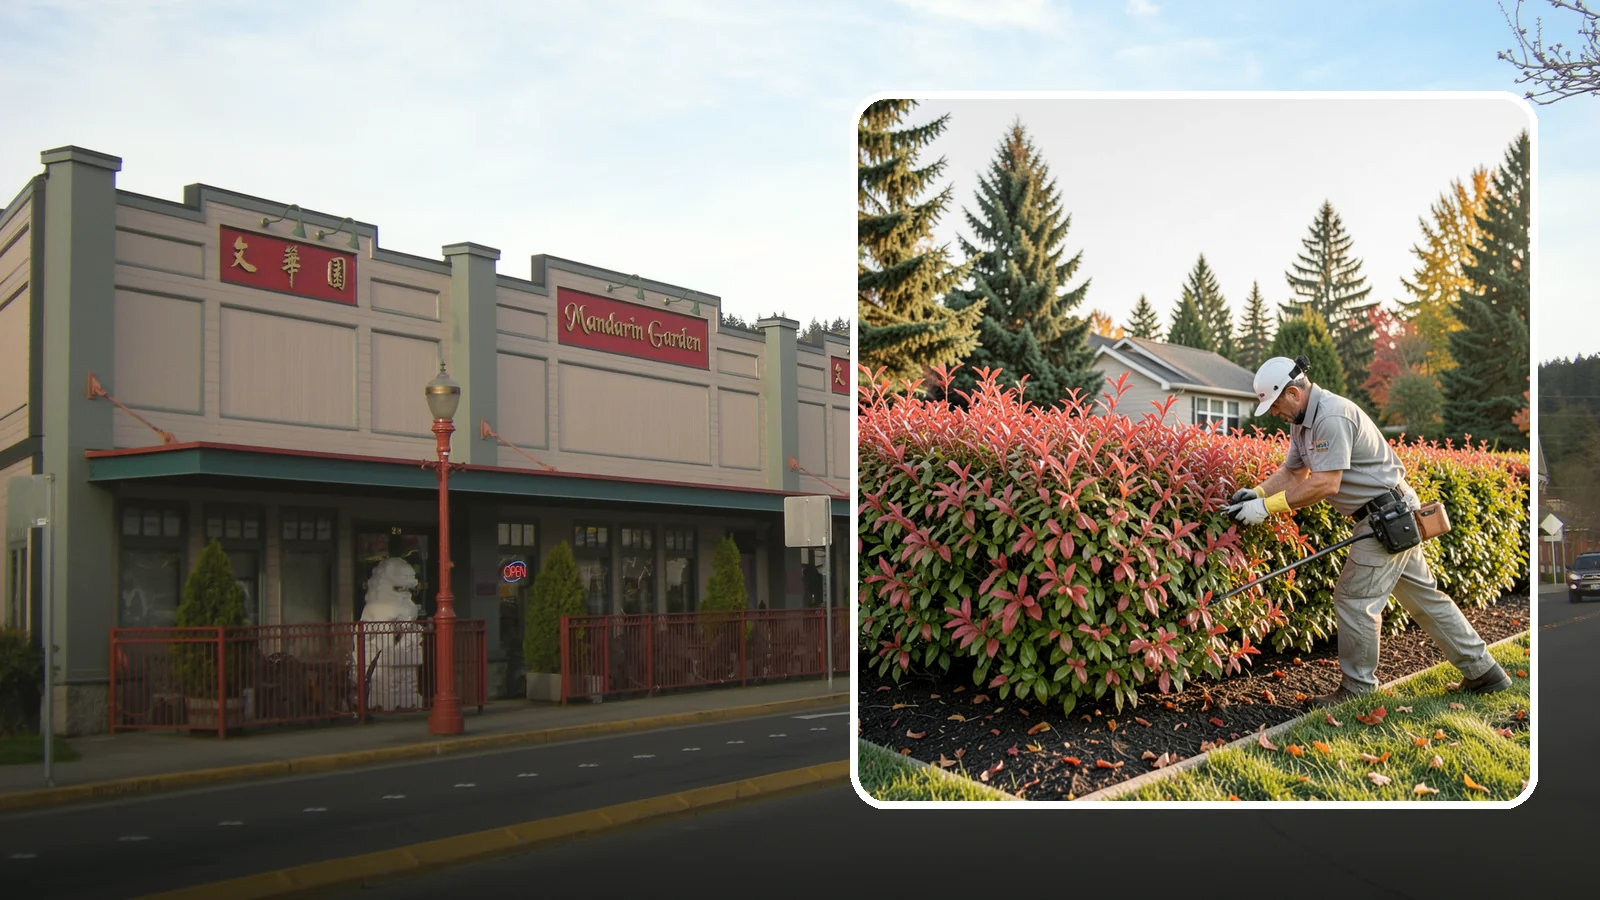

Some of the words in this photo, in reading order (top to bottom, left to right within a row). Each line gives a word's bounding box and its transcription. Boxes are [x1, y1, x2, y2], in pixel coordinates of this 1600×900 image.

[230, 236, 346, 291] 文華園
[564, 302, 644, 341] Mandarin
[648, 320, 702, 352] Garden
[503, 565, 527, 578] OPEN
